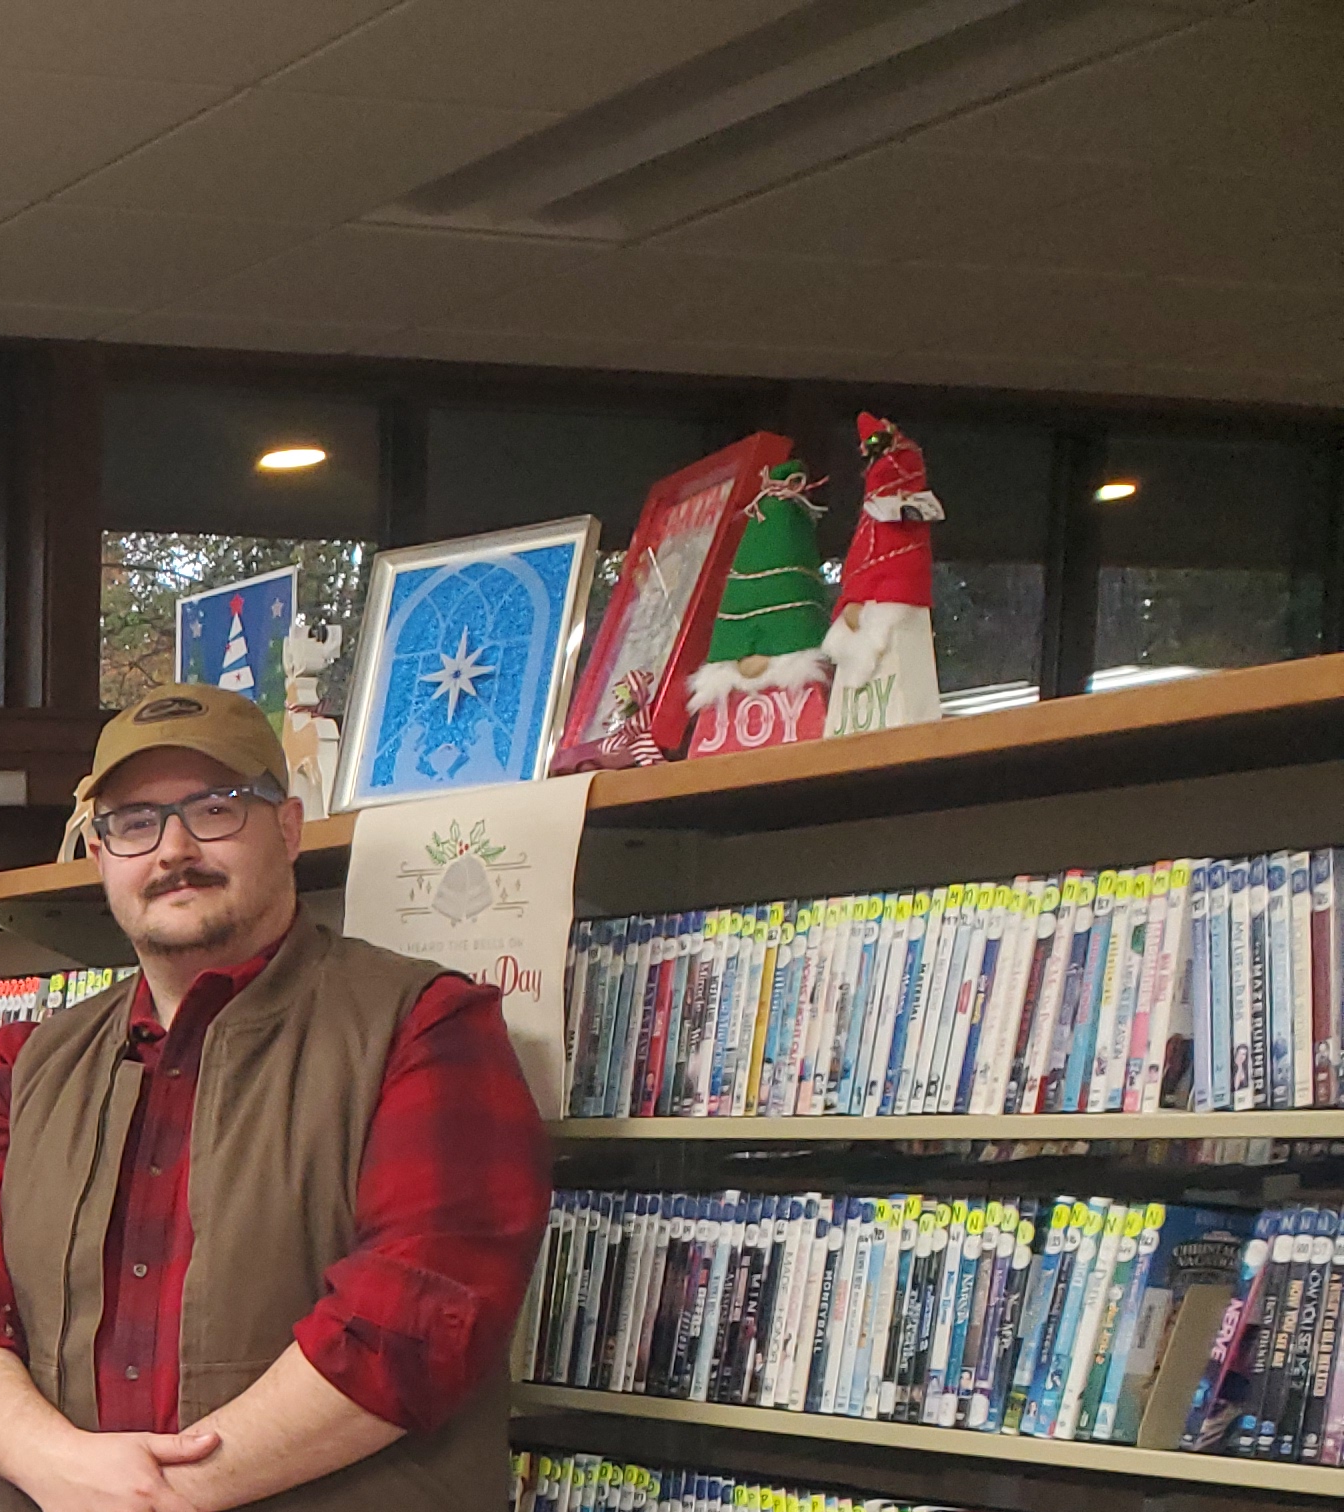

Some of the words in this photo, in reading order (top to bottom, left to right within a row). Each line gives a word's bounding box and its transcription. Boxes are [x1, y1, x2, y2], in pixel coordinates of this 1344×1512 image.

[698, 688, 814, 753] JOY
[834, 674, 897, 737] JOY
[494, 955, 543, 1003] Day
[1252, 1016, 1266, 1093] RUNNER
[1212, 1298, 1245, 1361] NERVE
